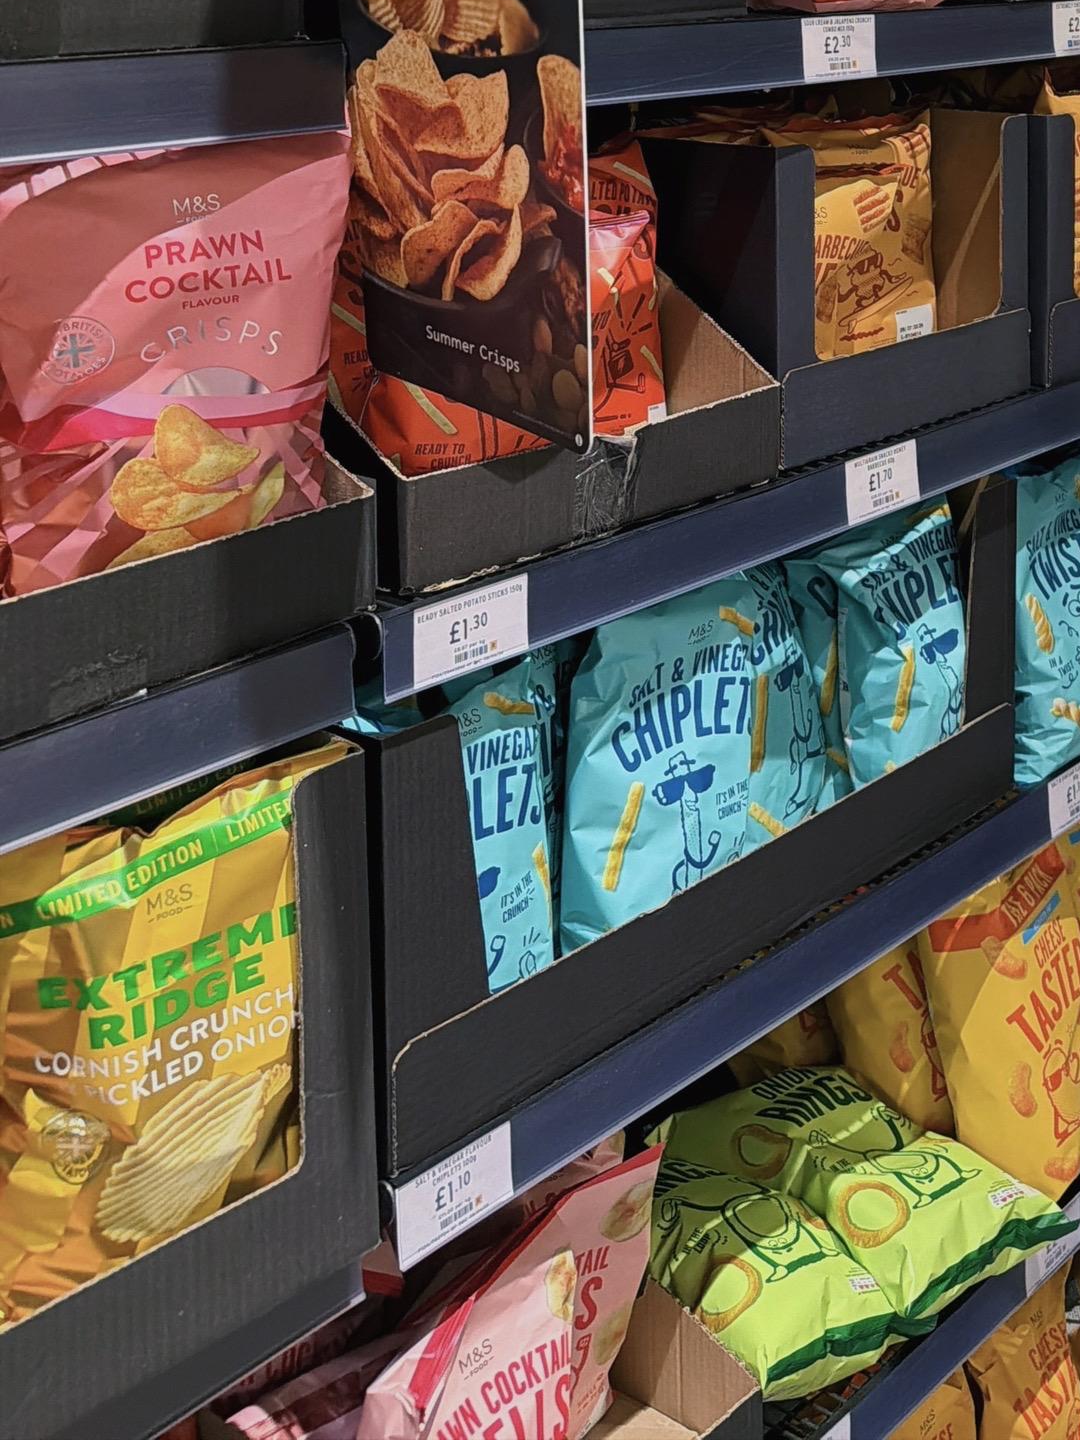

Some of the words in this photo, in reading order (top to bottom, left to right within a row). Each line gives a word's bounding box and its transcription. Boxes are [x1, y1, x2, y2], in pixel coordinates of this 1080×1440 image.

[824, 34, 851, 54] £2.30
[171, 193, 223, 216] M&S
[144, 229, 265, 269] PRAWN
[124, 257, 293, 304] COCKTAIL
[182, 294, 240, 310] FLAVOUR
[139, 315, 283, 364] CRISPS
[425, 325, 475, 355] Summer
[479, 346, 521, 374] Crisps
[343, 350, 368, 366] READ
[414, 443, 449, 456] READY
[450, 443, 466, 455] TO
[868, 467, 893, 493] £1.70
[417, 611, 438, 624] READY
[439, 602, 463, 618] SALTED
[463, 595, 487, 609] POTATO
[487, 589, 509, 601] STICKS
[448, 611, 489, 645] £1.30
[688, 619, 715, 640] M&S
[629, 662, 665, 709] SALT
[671, 656, 685, 683] &
[1057, 660, 1074, 679] TWIST
[611, 675, 752, 773] CHIPLET
[715, 789, 728, 807] IT'S
[736, 778, 749, 796] THE
[717, 801, 743, 821] CRUNCH
[35, 880, 123, 921] LIMITED
[126, 838, 204, 892] EDITION
[500, 889, 515, 909] IT'S
[521, 870, 534, 890] THE
[145, 882, 194, 916] M&S
[501, 899, 530, 924] CRUNCH
[1034, 915, 1068, 969] CHEESE
[87, 952, 266, 1052] RIDGE
[34, 1034, 163, 1081] CORNISH
[168, 982, 295, 1051] CRUNCH
[415, 1176, 431, 1189] SALT
[438, 1152, 465, 1174] VINEGAR
[465, 1135, 492, 1157] FLAVOUR
[432, 1164, 462, 1187] CHIPLETS
[435, 1170, 471, 1212] £1.10
[458, 1338, 493, 1374] M&S
[469, 1361, 489, 1377] FOOD
[480, 1331, 572, 1414] COCKTAIL
